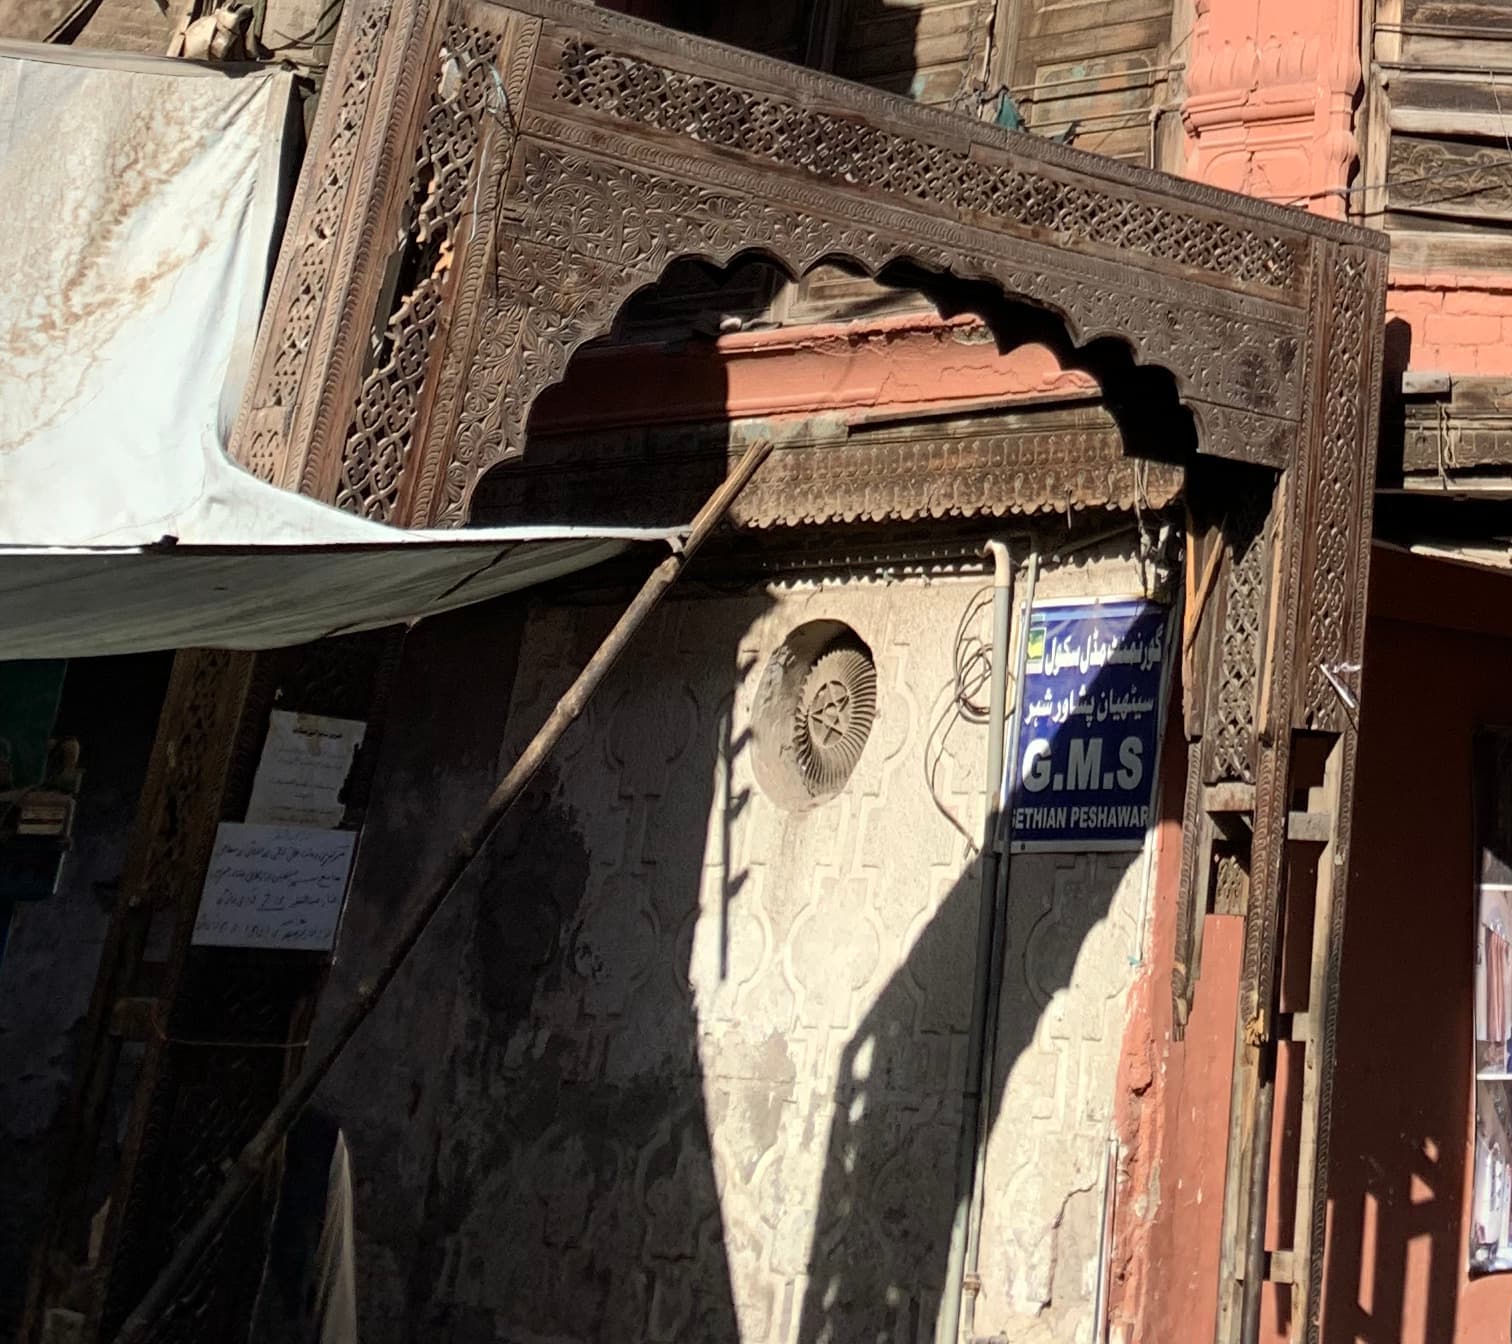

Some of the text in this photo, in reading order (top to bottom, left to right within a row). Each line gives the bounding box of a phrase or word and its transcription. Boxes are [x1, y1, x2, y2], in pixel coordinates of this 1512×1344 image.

[1045, 624, 1163, 677] گورنمنٹ مڈل سکول
[1024, 687, 1052, 728] شہر
[1052, 684, 1095, 728] پشاور
[1022, 736, 1143, 792] G.M.S
[1070, 805, 1150, 828] PESHAWAR
